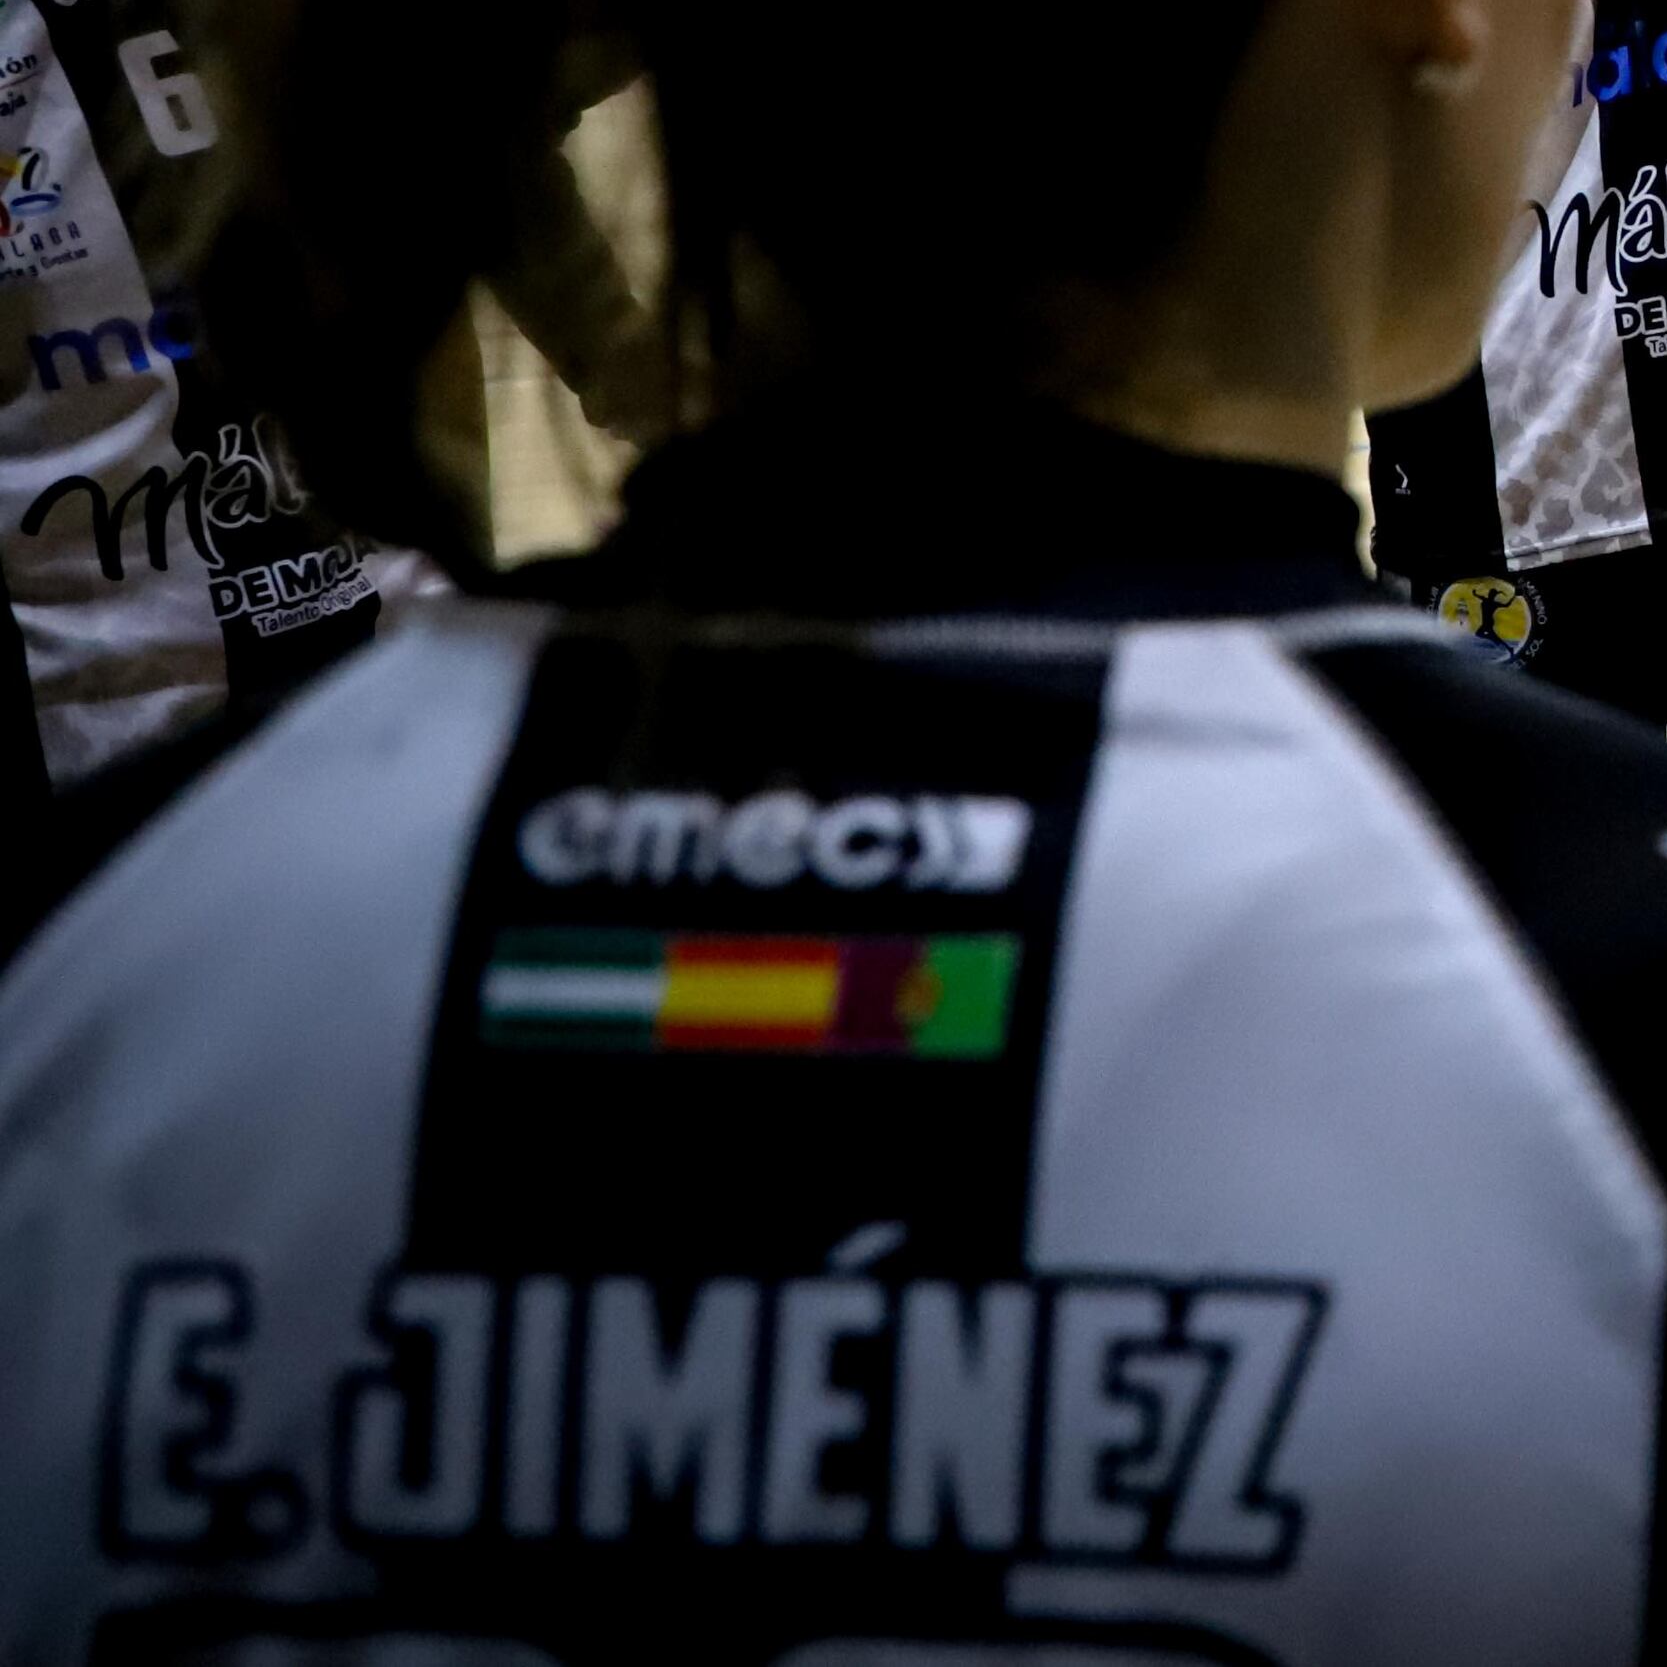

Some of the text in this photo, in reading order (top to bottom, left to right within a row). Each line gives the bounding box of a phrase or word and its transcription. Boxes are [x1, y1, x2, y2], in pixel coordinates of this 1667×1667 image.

[118, 29, 219, 158] 6
[1617, 304, 1667, 333] DE
[213, 572, 273, 619] DE
[258, 578, 372, 635] Talento Original
[517, 784, 905, 892] emec
